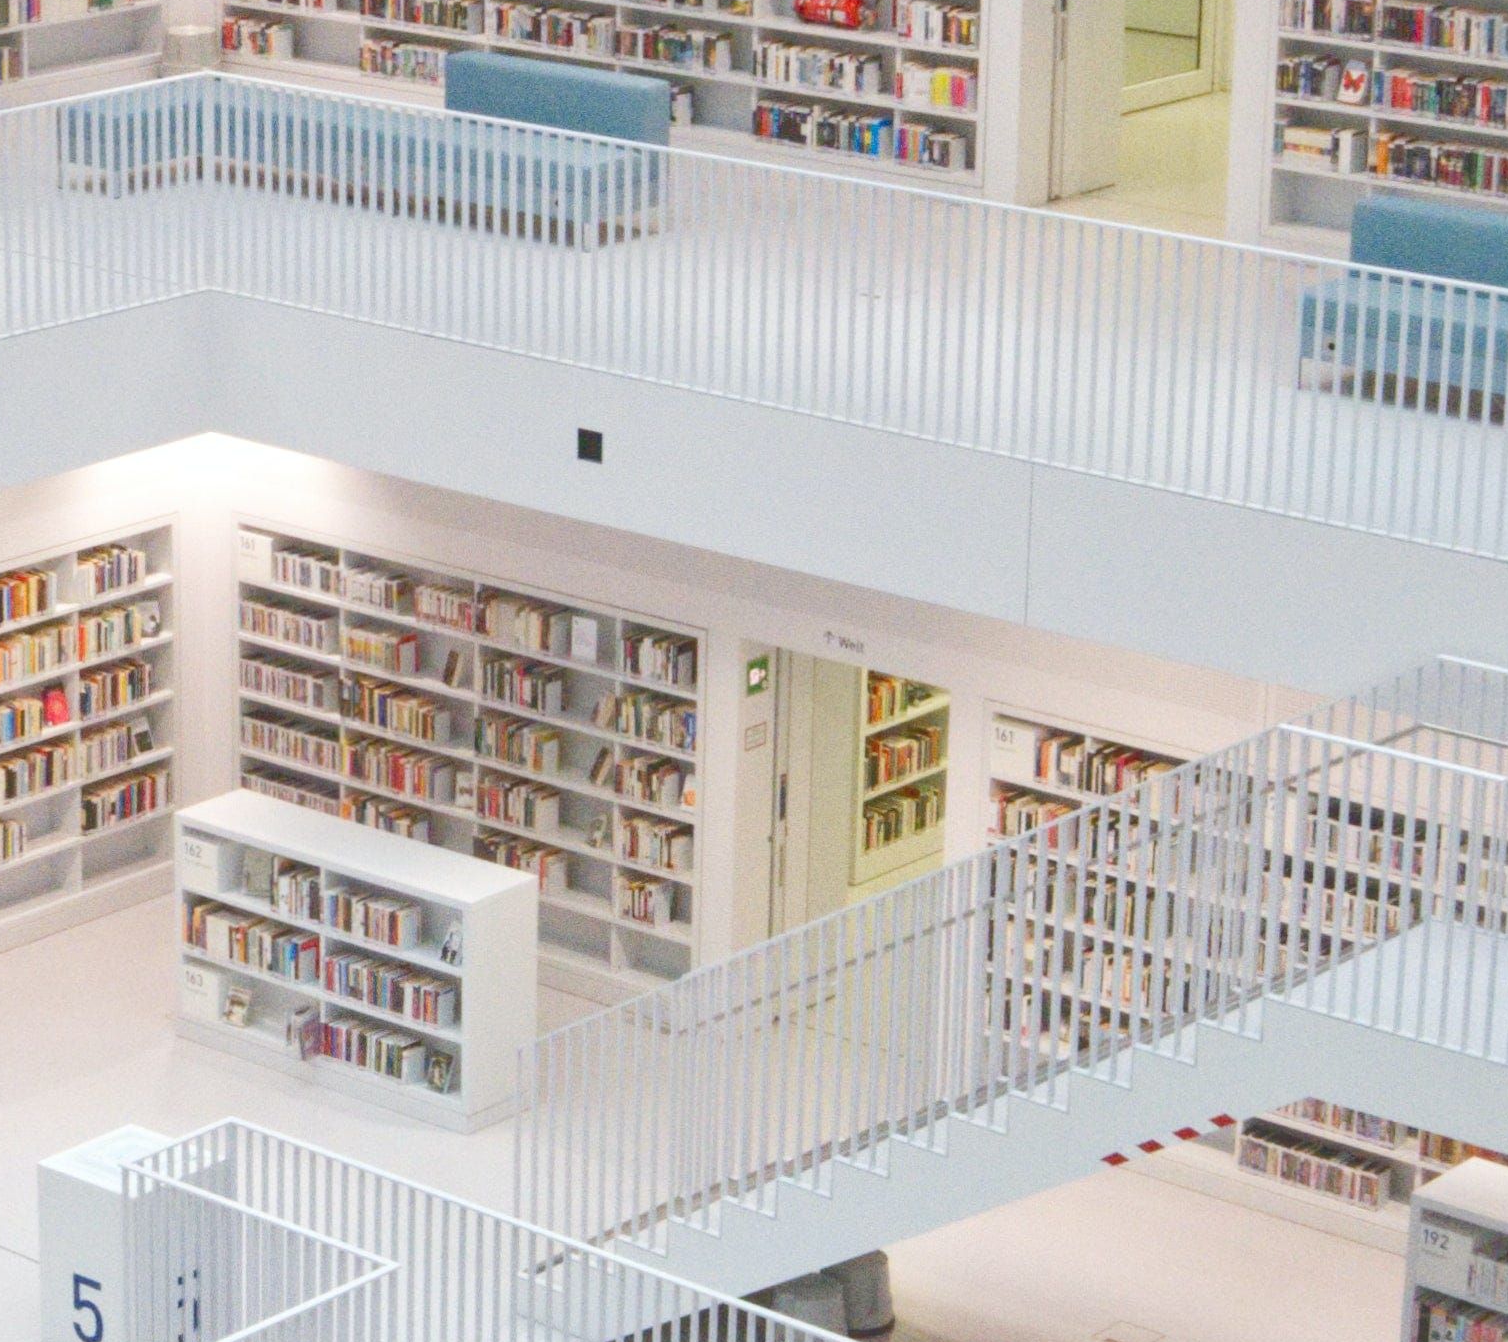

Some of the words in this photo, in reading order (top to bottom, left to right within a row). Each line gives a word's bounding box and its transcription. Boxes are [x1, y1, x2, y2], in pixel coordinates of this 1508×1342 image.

[838, 636, 865, 654] Welt
[995, 727, 1014, 745] 161
[184, 841, 202, 858] 162
[1424, 1228, 1450, 1251] 192
